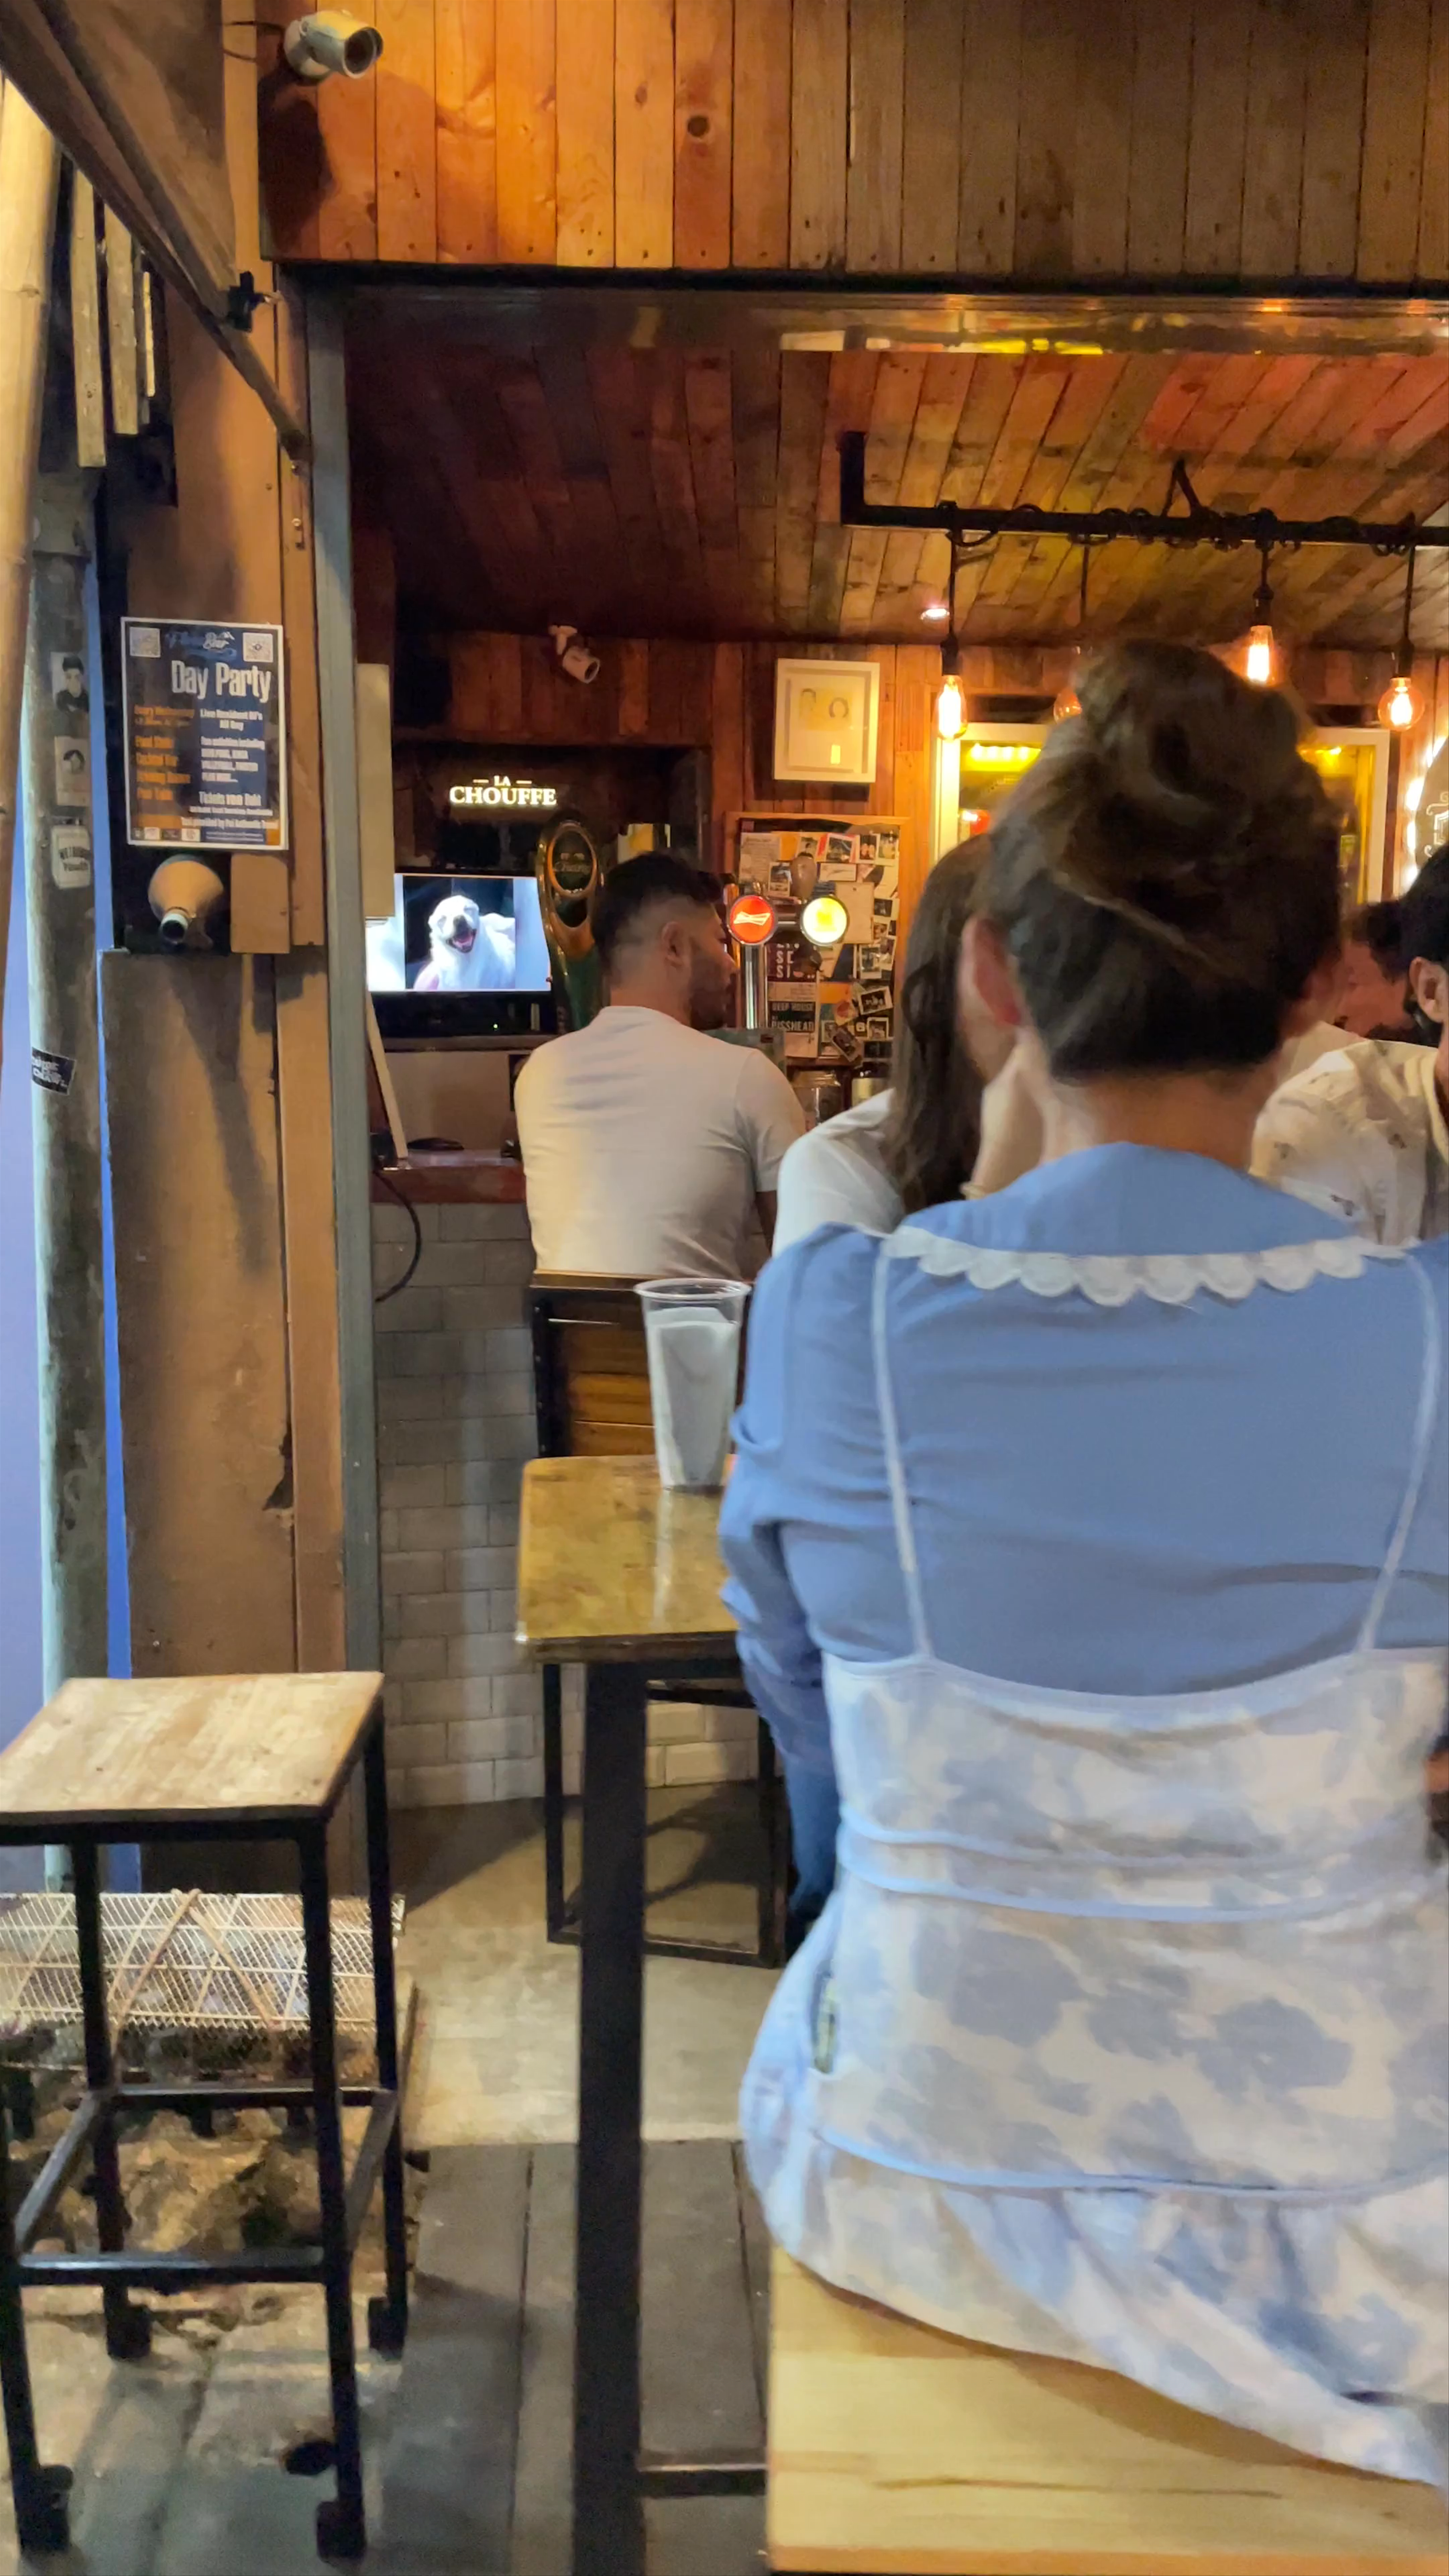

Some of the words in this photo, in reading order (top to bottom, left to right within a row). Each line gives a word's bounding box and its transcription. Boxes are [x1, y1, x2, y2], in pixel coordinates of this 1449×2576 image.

[171, 660, 208, 700] Day
[215, 662, 271, 703] Party
[493, 775, 511, 786] LA
[449, 786, 557, 805] CHOUFFE
